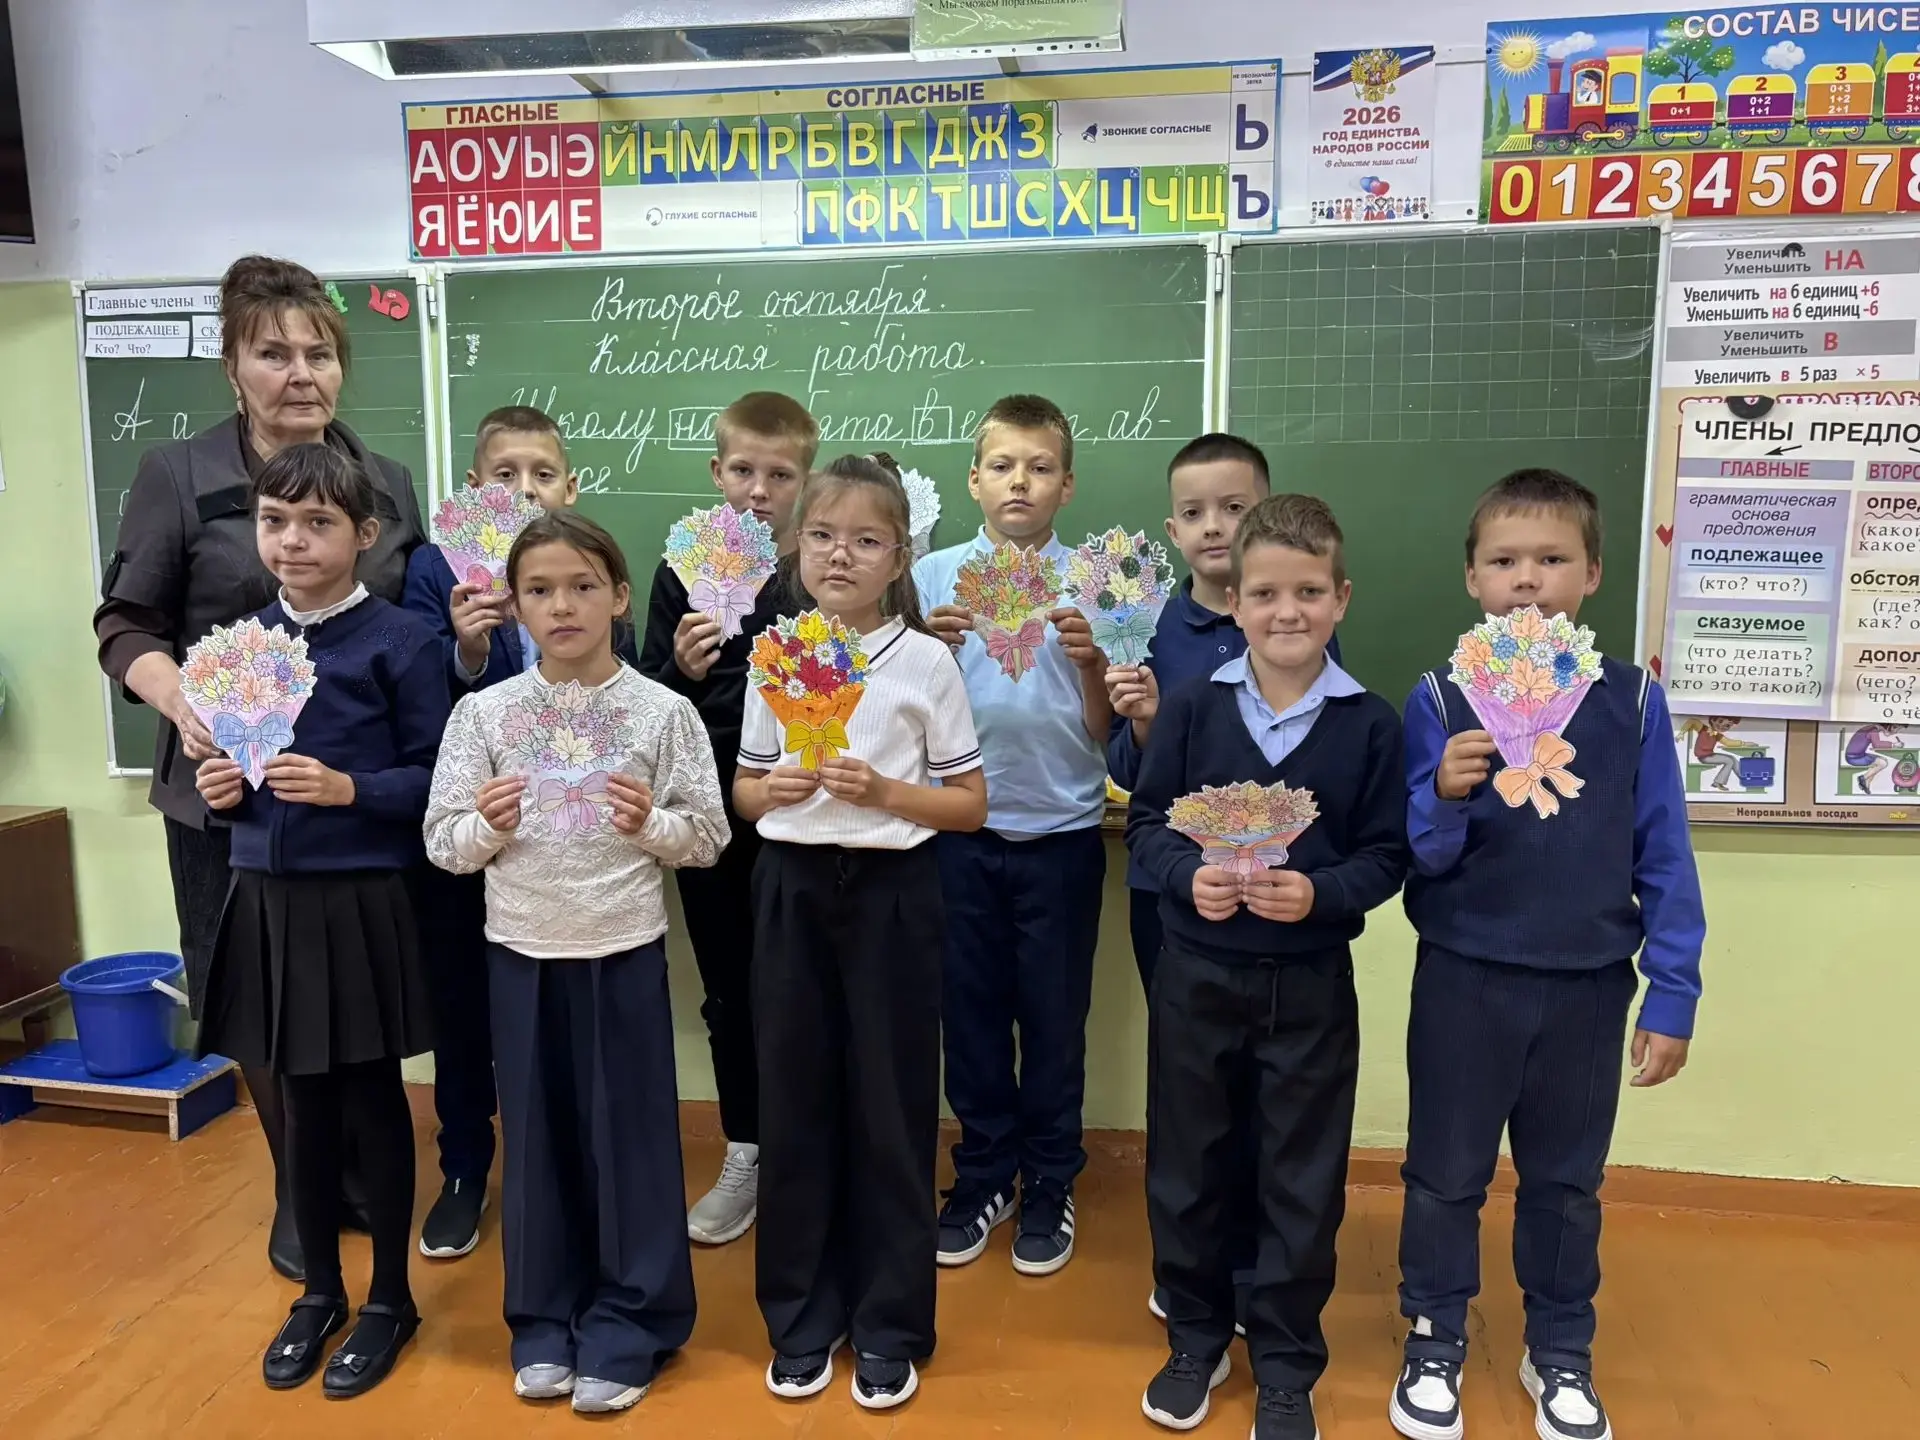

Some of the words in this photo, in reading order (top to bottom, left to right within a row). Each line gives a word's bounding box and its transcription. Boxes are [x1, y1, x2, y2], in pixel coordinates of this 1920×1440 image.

[1683, 9, 1820, 39] СОСТАВ
[1835, 66, 1847, 80] 3
[1755, 76, 1768, 91] 2
[1829, 84, 1851, 92] 0+3
[827, 82, 985, 108] СОГЛАСНЫЕ
[1677, 86, 1686, 100] 1
[1749, 96, 1772, 105] 0+2
[1829, 95, 1851, 103] 1+2
[446, 103, 559, 126] ГЛАСНЫЕ
[1343, 105, 1401, 126] 2026
[1670, 107, 1691, 115] 0+1
[1749, 107, 1770, 115] 1+1
[1828, 105, 1849, 114] 2+1
[1102, 127, 1147, 136] ЗВОНКИЕ
[1150, 124, 1212, 134] СОГЛАСНЫЕ
[1322, 131, 1348, 141] ГОД
[1351, 127, 1421, 140] ЕДИНСТВА
[1312, 143, 1373, 154] НАРОДОВ
[1377, 140, 1430, 152] РОССИИ
[665, 212, 699, 220] ГЛУХИЕ
[701, 210, 758, 219] СОГЛАСНЫЕ
[1824, 249, 1865, 271] НА
[1724, 262, 1811, 274] Уменьшить
[1684, 286, 1760, 302] Увеличить
[1770, 288, 1787, 299] на
[1791, 284, 1800, 299] 6
[1803, 284, 1858, 300] единиц
[1861, 281, 1880, 296] +6
[89, 297, 147, 310] Главные
[151, 297, 194, 308] члены
[1687, 306, 1769, 322] Уменьшить
[1772, 307, 1789, 319] на
[1793, 302, 1802, 318] 6
[1805, 303, 1860, 319] единиц
[95, 325, 180, 337] ПОДЛЕЖАЩЕЕ
[1723, 329, 1804, 341] Увеличить
[1823, 332, 1838, 351] В
[95, 343, 120, 354] Кто?
[128, 343, 151, 354] Что?
[1721, 344, 1808, 357] Уменьшить
[1694, 368, 1771, 385] Увеличить
[1781, 370, 1790, 381] в
[1800, 366, 1809, 381] 5
[1813, 368, 1837, 384] раз
[111, 377, 153, 441] А
[1695, 421, 1793, 441] ЧЛЕНЫ
[1720, 460, 1811, 477] ГЛАВНЫЕ
[1689, 494, 1837, 508] грамматическая
[1731, 508, 1790, 521] основа
[1703, 522, 1816, 538] предложения
[1691, 548, 1824, 565] подлежащее
[1699, 575, 1748, 594] (кто?
[1757, 577, 1808, 596] что?)
[1697, 615, 1805, 633] сказуемое
[1857, 615, 1902, 630] как?
[1688, 643, 1726, 660] (что
[1734, 647, 1812, 662] делать?
[1684, 663, 1717, 675] что
[1725, 664, 1813, 678] сделать?
[1671, 680, 1703, 690] кто
[1711, 681, 1742, 691] это
[1750, 681, 1822, 698] такой?)
[1856, 673, 1916, 692] (чего?
[1868, 690, 1912, 704] что?
[1737, 807, 1812, 818] Неправильная
[1816, 810, 1859, 820] посадка
